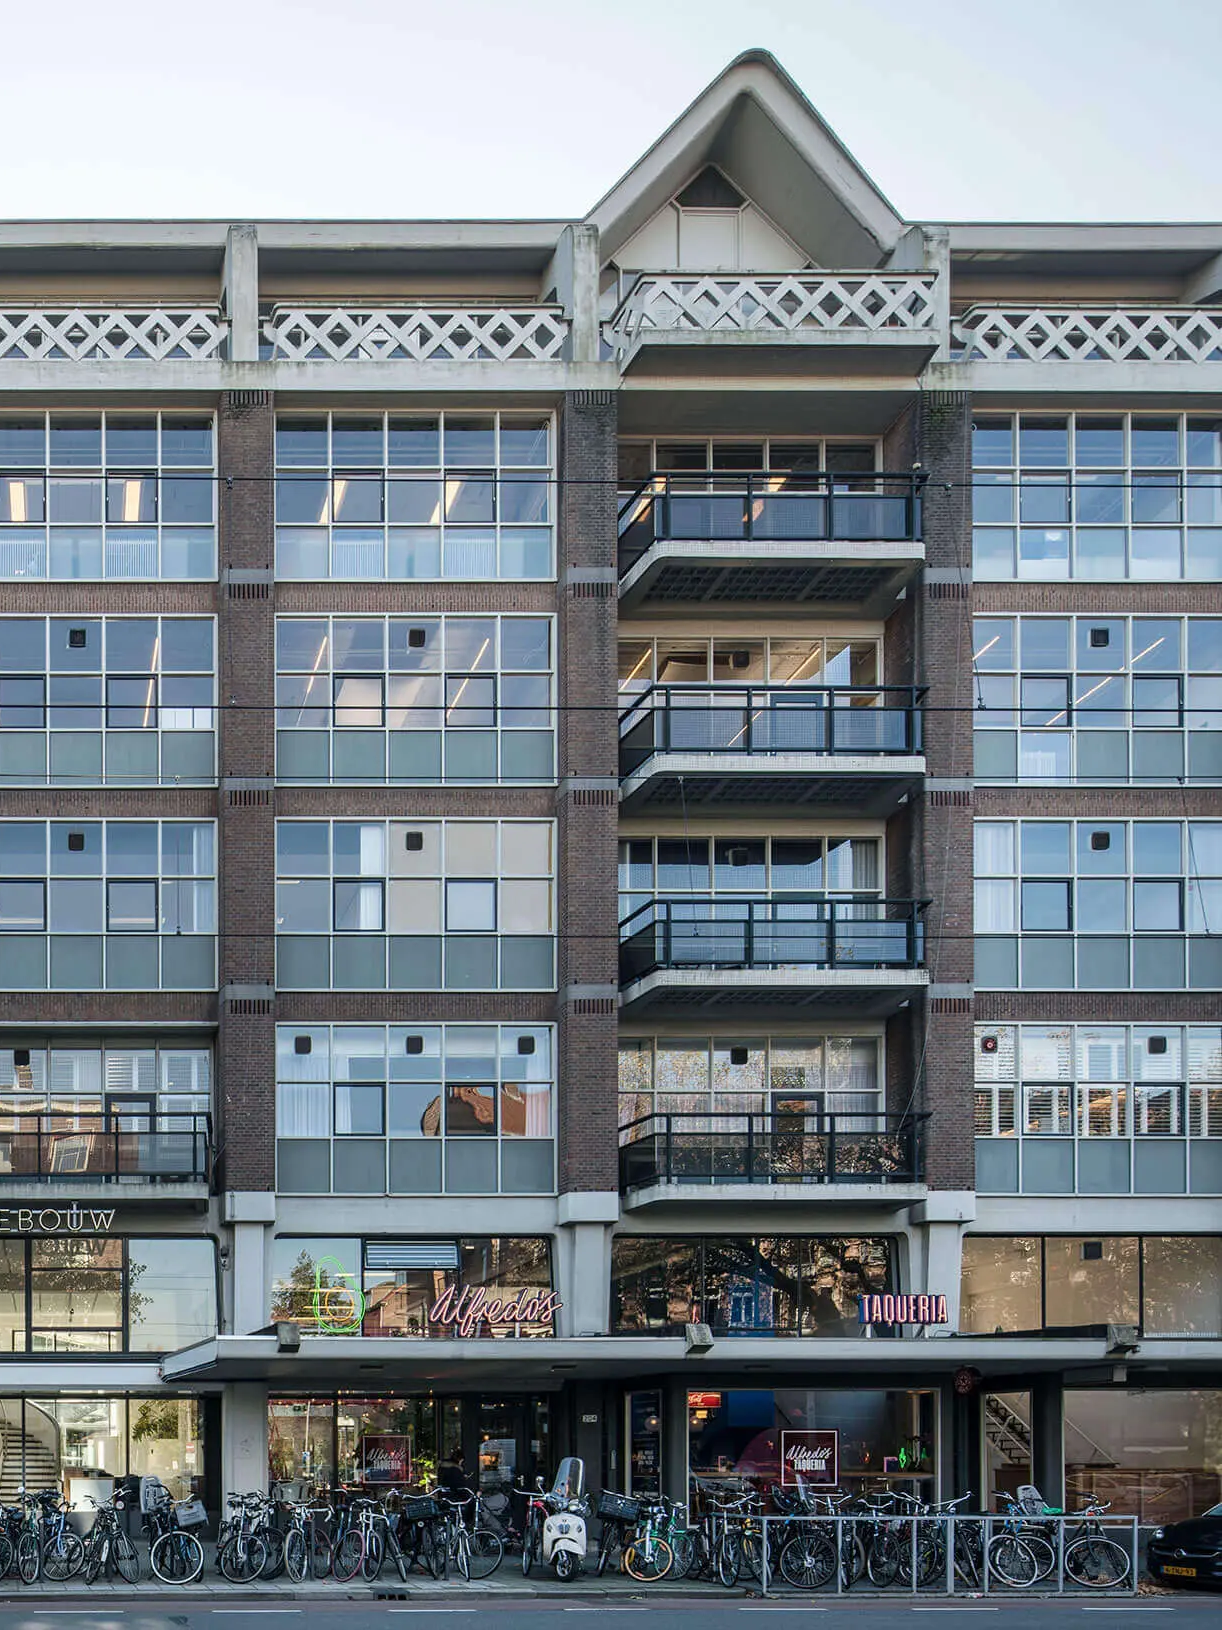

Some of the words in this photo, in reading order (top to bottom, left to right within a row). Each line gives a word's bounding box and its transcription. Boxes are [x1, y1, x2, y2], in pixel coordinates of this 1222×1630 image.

[429, 1283, 563, 1337] Alfredo's
[859, 1294, 949, 1327] TAQUERIA
[785, 1444, 833, 1461] Alfredo's
[373, 1460, 402, 1471] TAQUERIA
[794, 1459, 827, 1472] TAQUERIA
